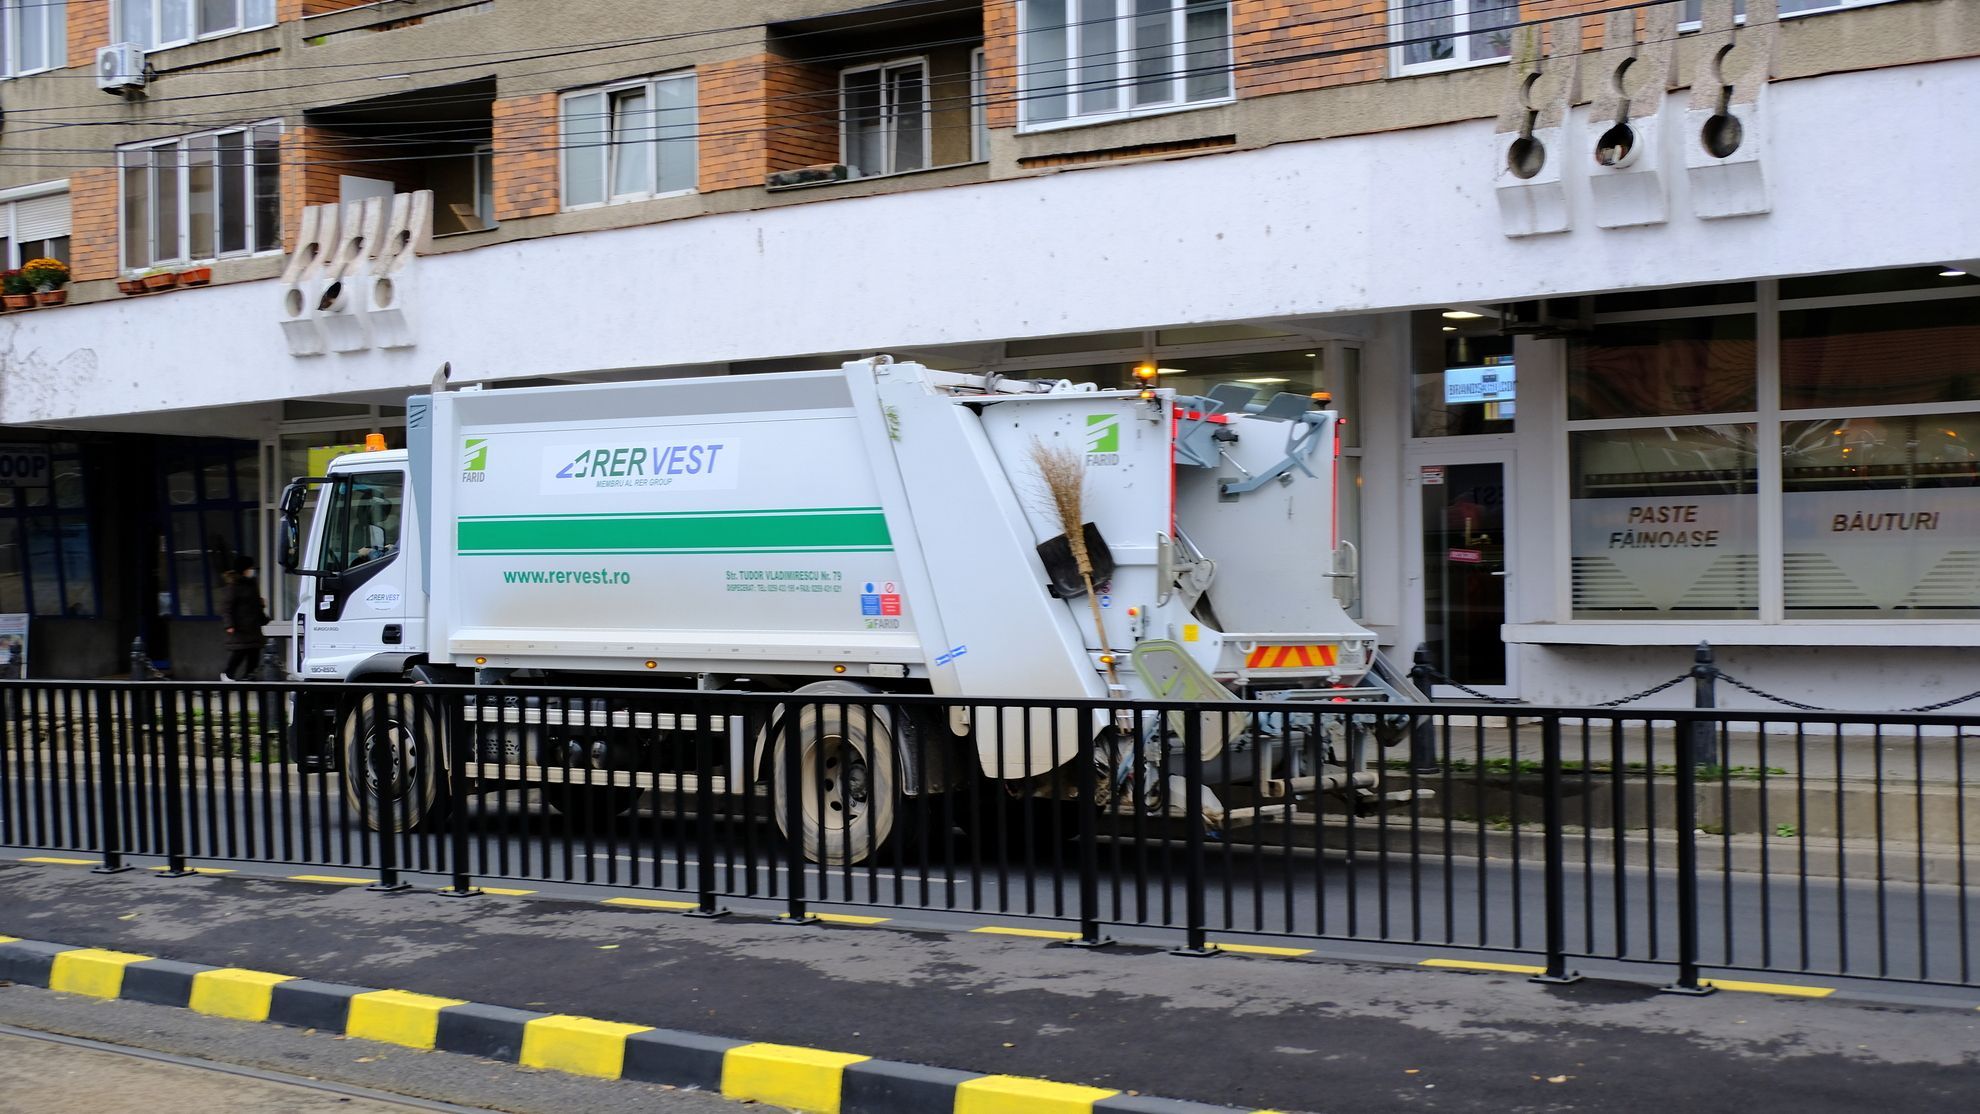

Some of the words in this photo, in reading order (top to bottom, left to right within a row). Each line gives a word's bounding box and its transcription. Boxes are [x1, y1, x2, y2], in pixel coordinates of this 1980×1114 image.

[590, 447, 648, 478] RER
[652, 444, 724, 475] VEST
[1086, 453, 1120, 467] FARID
[462, 471, 486, 483] FARID
[596, 479, 624, 488] MEMBRU
[624, 479, 633, 487] AL
[649, 477, 673, 486] GROUP
[1627, 504, 1699, 524] PASTE
[503, 568, 631, 585] www.rervest.ro
[725, 570, 738, 581] Str.
[739, 570, 764, 581] TUDOR
[764, 570, 820, 581] VLADIMIRESCU
[820, 570, 832, 581] Nr.
[874, 618, 900, 629] FARID
